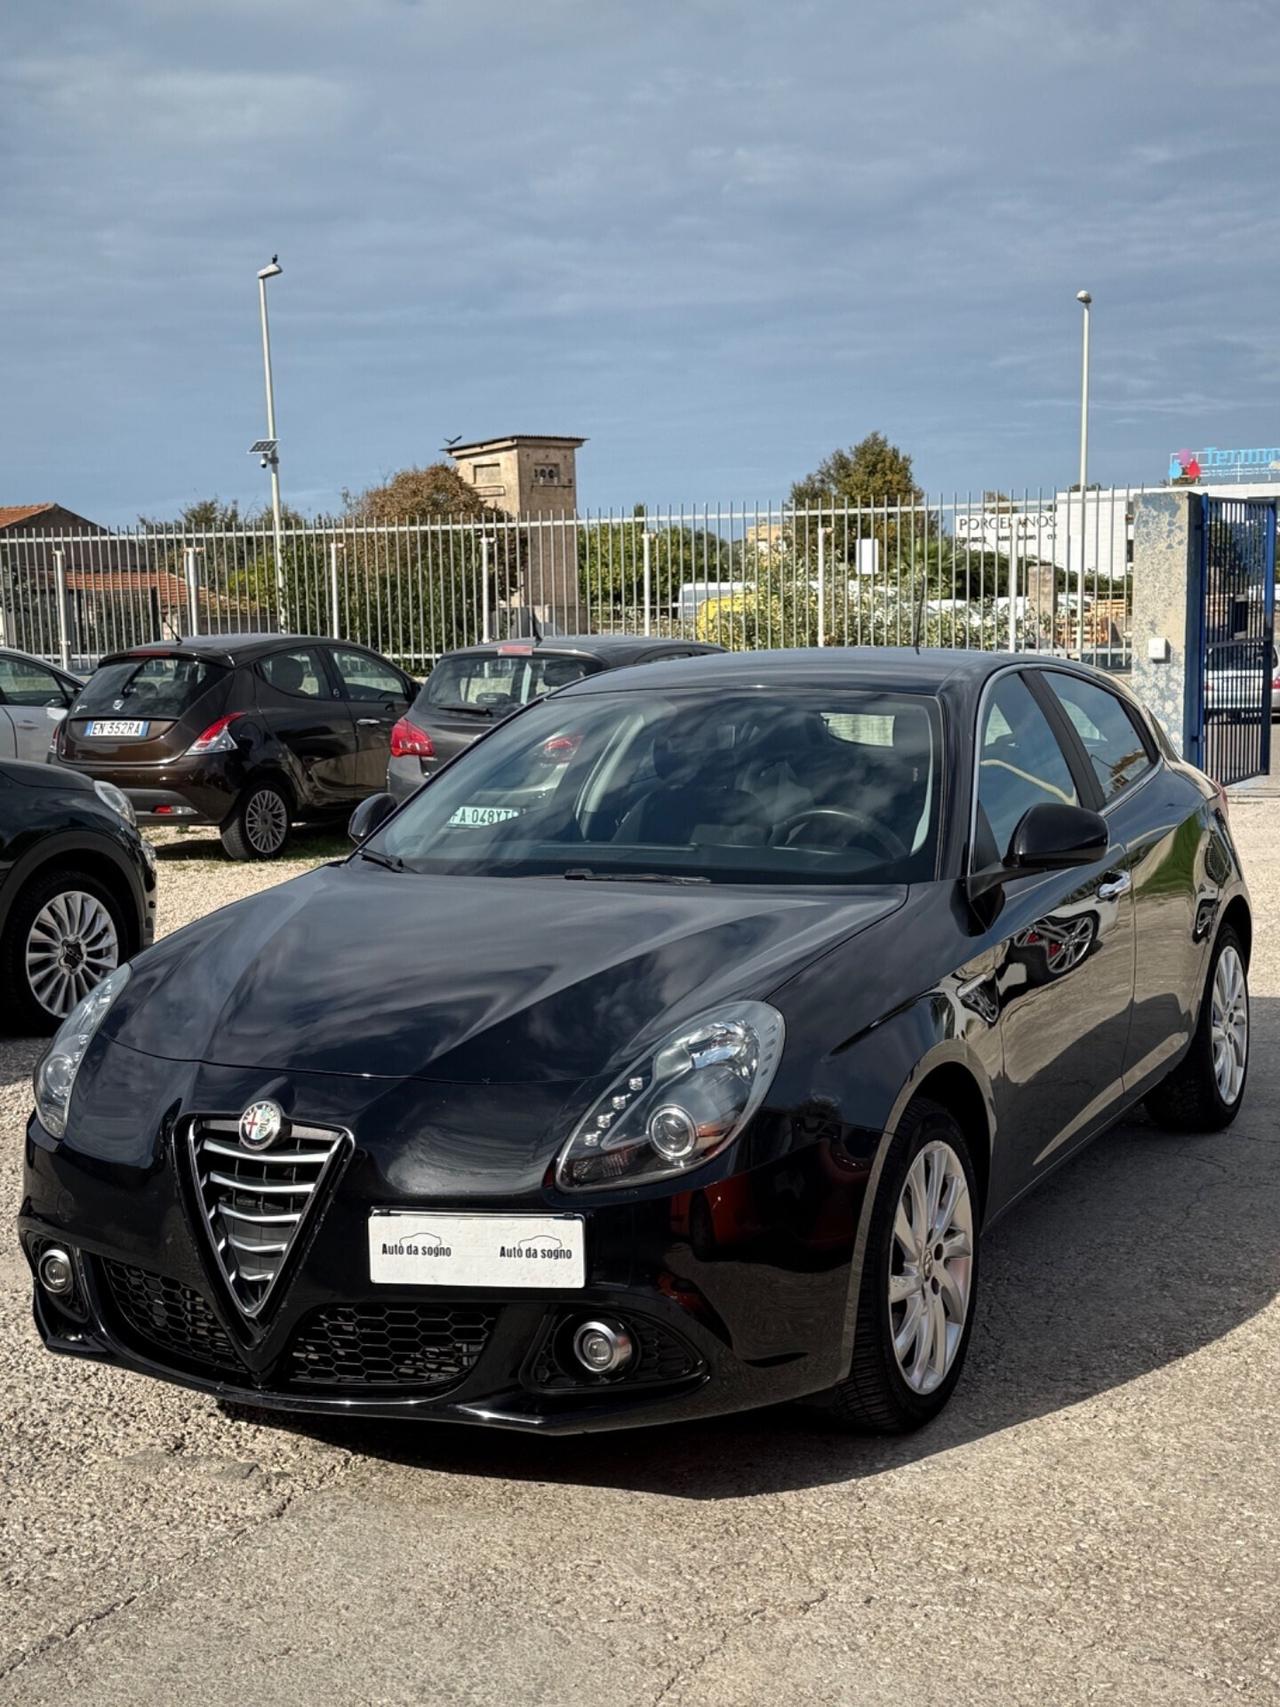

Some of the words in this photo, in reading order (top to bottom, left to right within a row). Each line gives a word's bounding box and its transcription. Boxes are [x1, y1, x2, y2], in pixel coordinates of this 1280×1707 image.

[92, 722, 105, 735] EN
[472, 809, 511, 824] 048YT
[382, 1243, 404, 1255] Auto
[406, 1244, 419, 1256] da
[421, 1245, 452, 1258] sogno
[499, 1246, 523, 1258] Auto
[525, 1247, 538, 1259] da
[540, 1248, 572, 1260] sogno
